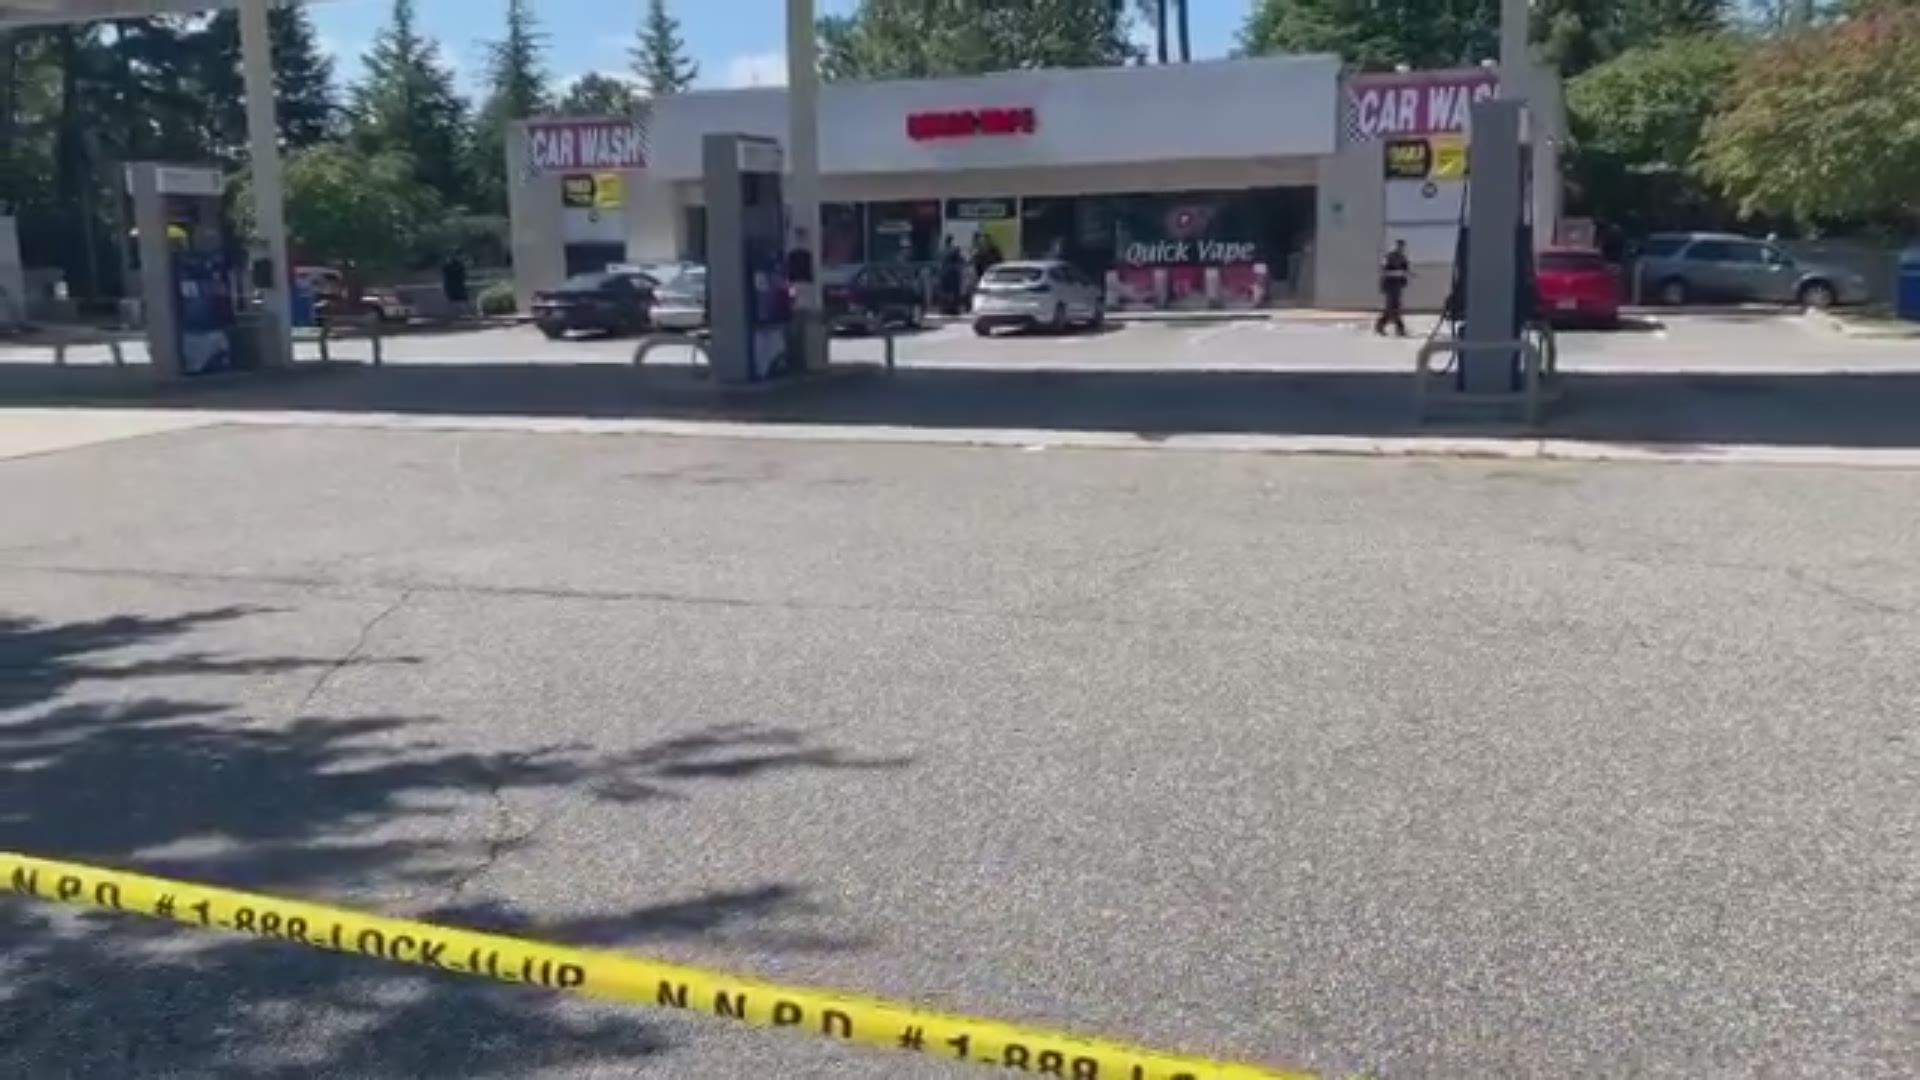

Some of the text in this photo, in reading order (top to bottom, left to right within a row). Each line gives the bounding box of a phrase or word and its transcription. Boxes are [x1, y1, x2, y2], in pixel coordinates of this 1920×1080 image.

[1359, 83, 1500, 133] CAR WA
[531, 124, 642, 166] CAR WASH
[1126, 238, 1255, 266] Quick Vape
